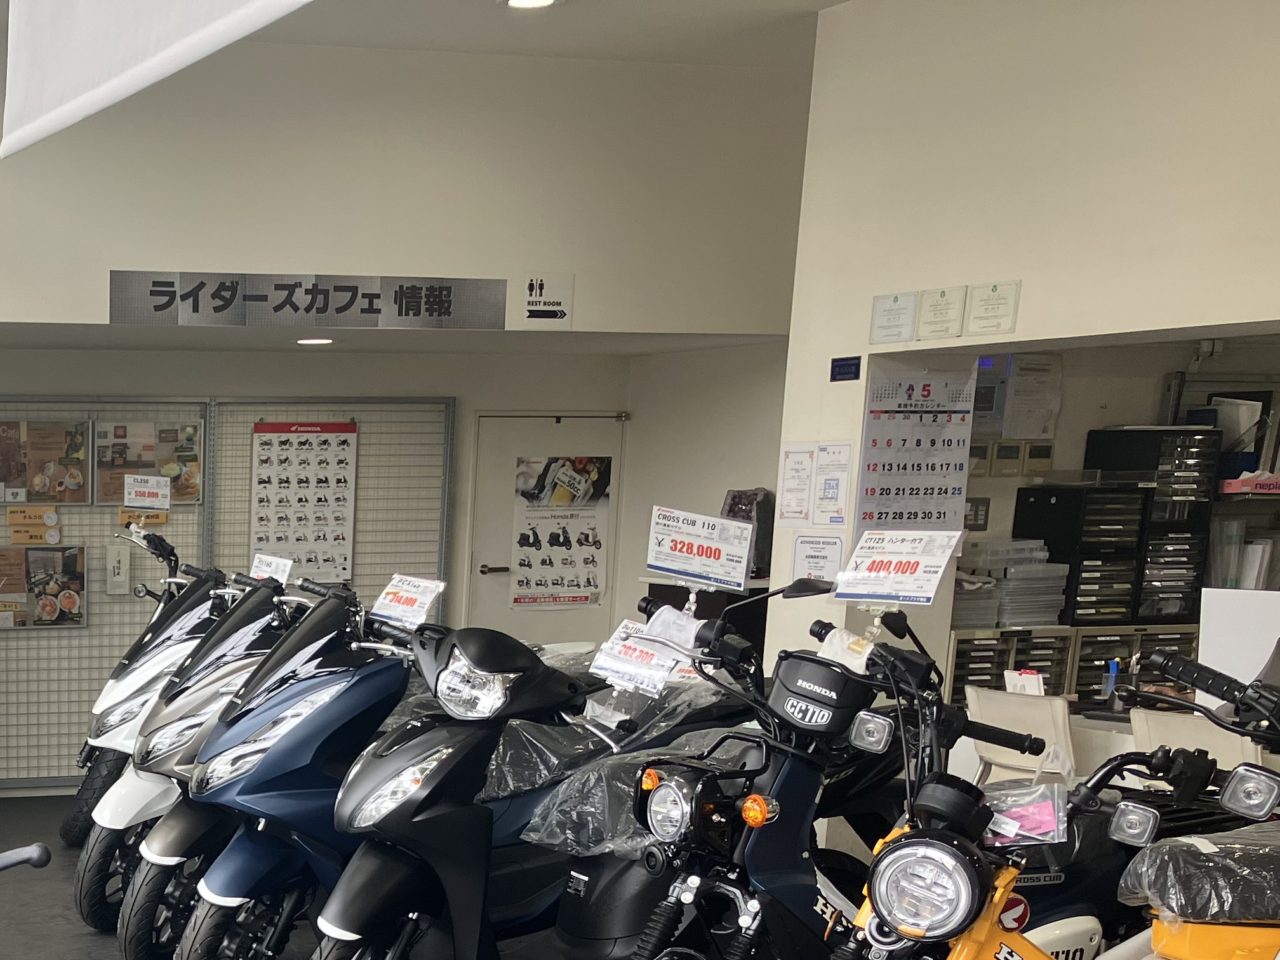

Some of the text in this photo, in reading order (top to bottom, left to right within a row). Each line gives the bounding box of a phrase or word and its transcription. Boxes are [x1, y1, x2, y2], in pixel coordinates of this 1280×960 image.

[148, 279, 453, 318] ライダーズカフェ 情報
[921, 383, 932, 399] 5
[932, 414, 938, 422] 2
[946, 414, 952, 422] 3
[960, 414, 966, 422] 4
[871, 439, 965, 447] 5 6 7 8 9 10 11
[867, 463, 964, 472] 12 13 14 15 16 17 18
[865, 487, 962, 496] 19 20 21 22 23 24 25
[862, 511, 874, 520] 26
[877, 511, 889, 520] 27
[892, 511, 904, 520] 28
[906, 511, 918, 520] 29
[921, 511, 933, 520] 30
[936, 511, 946, 520] 31
[657, 513, 716, 531] CROSS CUB 110
[670, 539, 722, 561] 328,000
[796, 679, 838, 700] HONDA
[786, 699, 829, 723] CC110
[1014, 874, 1062, 883] ROSS CUB
